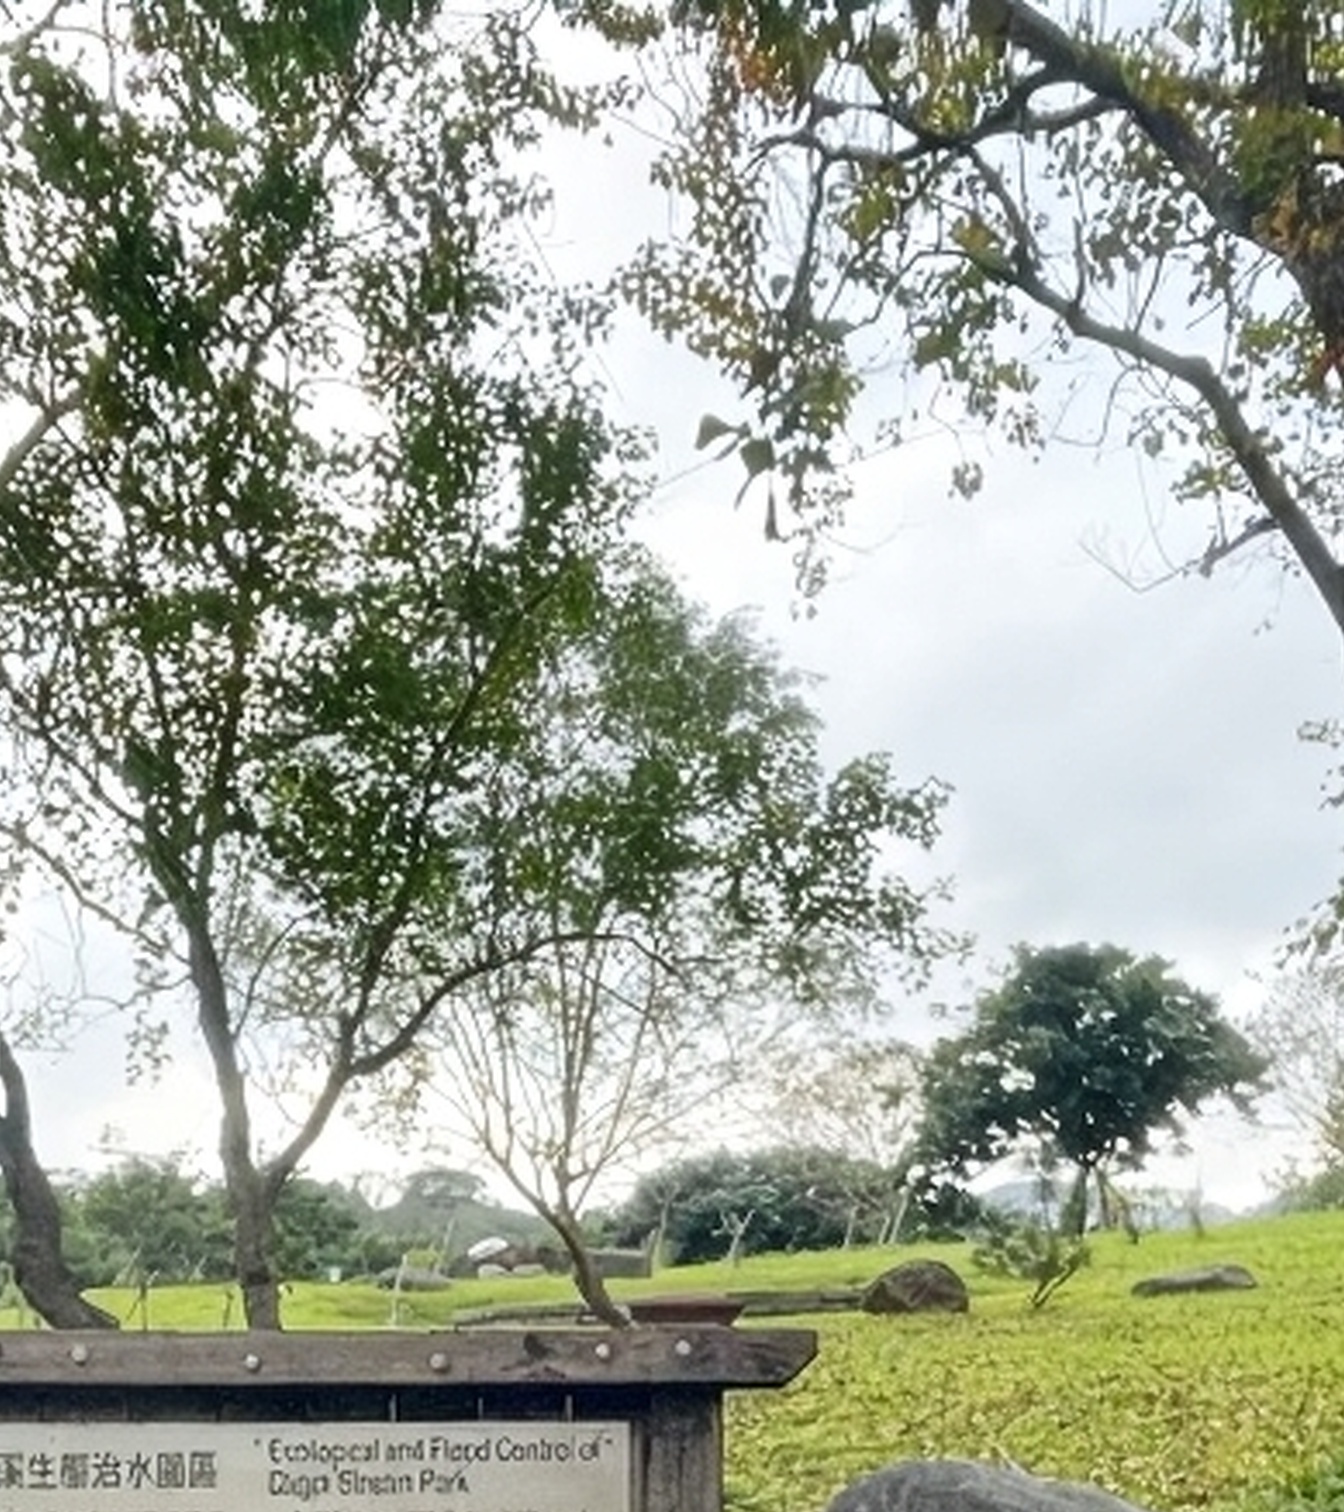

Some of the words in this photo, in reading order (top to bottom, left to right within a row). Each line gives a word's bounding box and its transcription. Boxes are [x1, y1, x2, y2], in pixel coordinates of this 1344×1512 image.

[269, 1438, 379, 1472] Ecological
[386, 1439, 425, 1461] and
[430, 1437, 491, 1462] Flood
[496, 1437, 575, 1462] Control
[578, 1434, 601, 1462] of
[418, 1469, 470, 1494] Park
